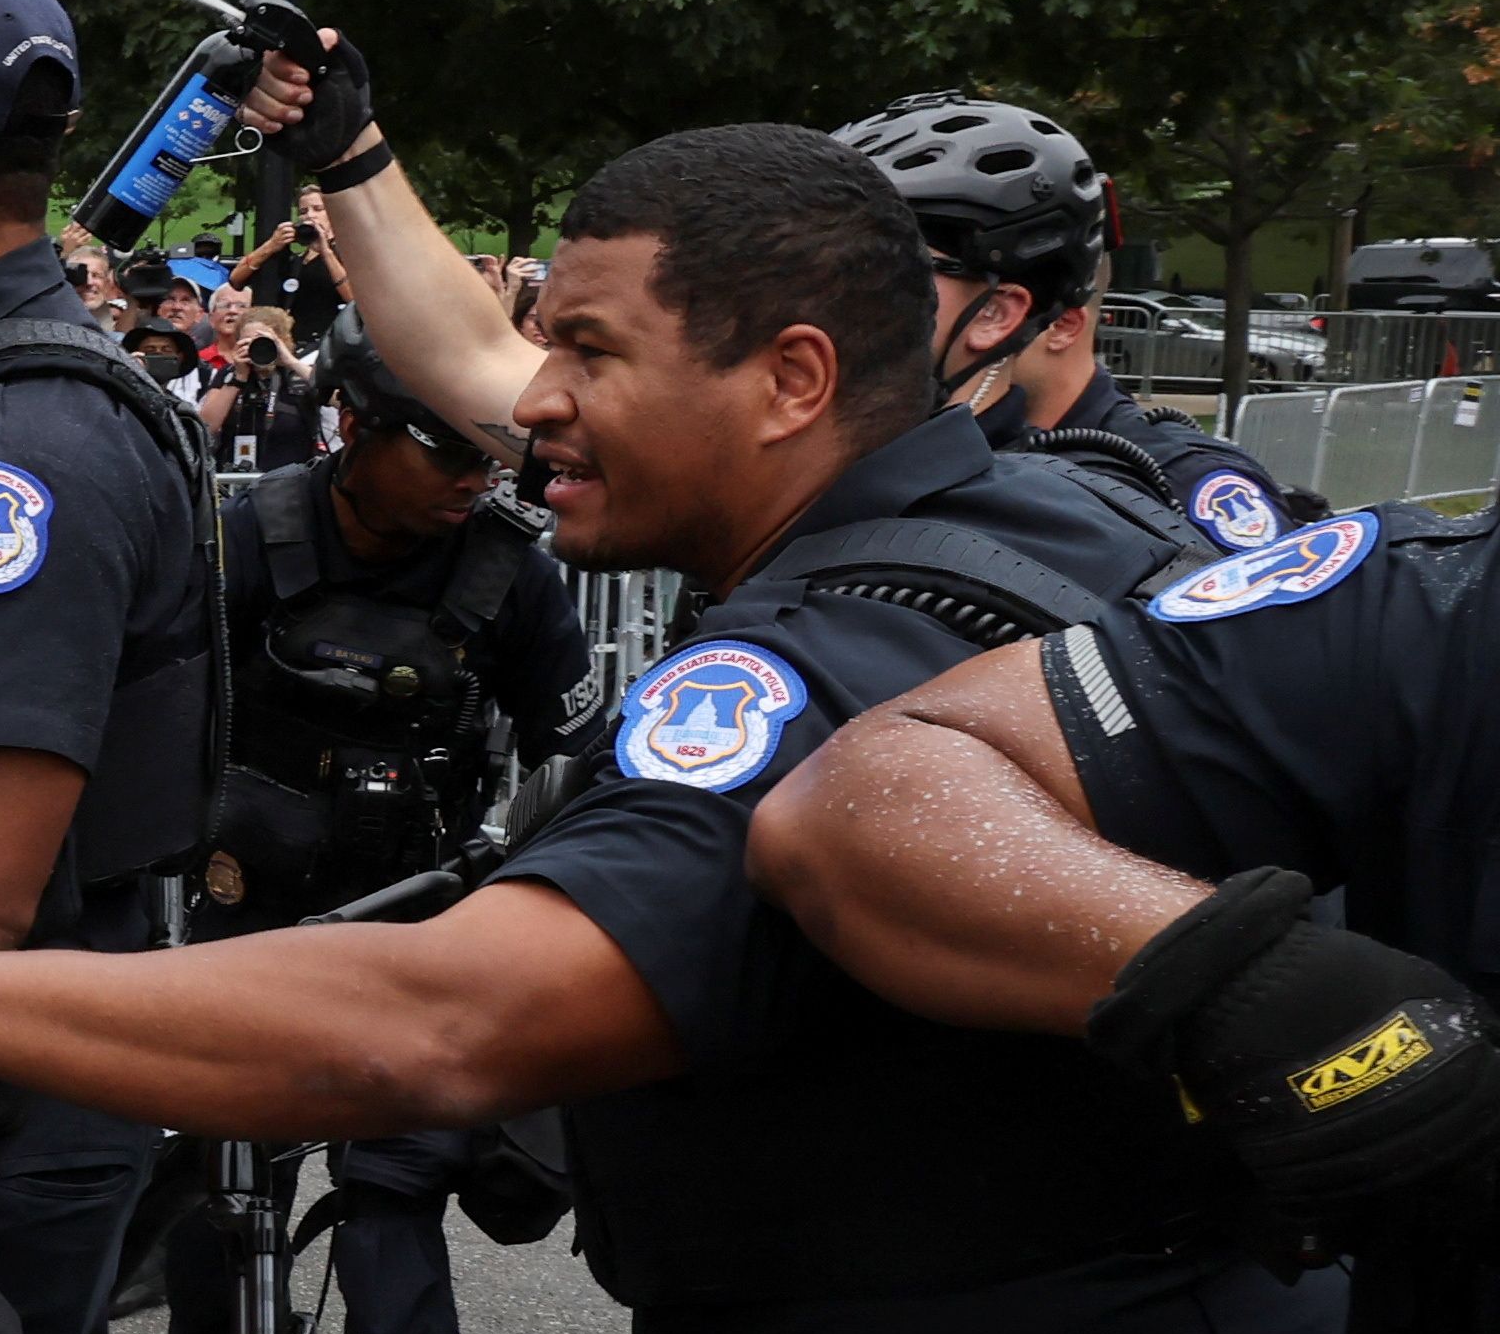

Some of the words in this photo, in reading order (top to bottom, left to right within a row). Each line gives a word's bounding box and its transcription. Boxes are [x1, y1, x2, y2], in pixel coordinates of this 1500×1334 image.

[2, 39, 32, 67] UNITED
[16, 482, 40, 507] POLICE
[642, 671, 677, 701] UNITED
[677, 654, 719, 674] STATES
[719, 652, 763, 675] CAPITOL
[760, 670, 788, 703] POLICE
[675, 744, 708, 758] 1828
